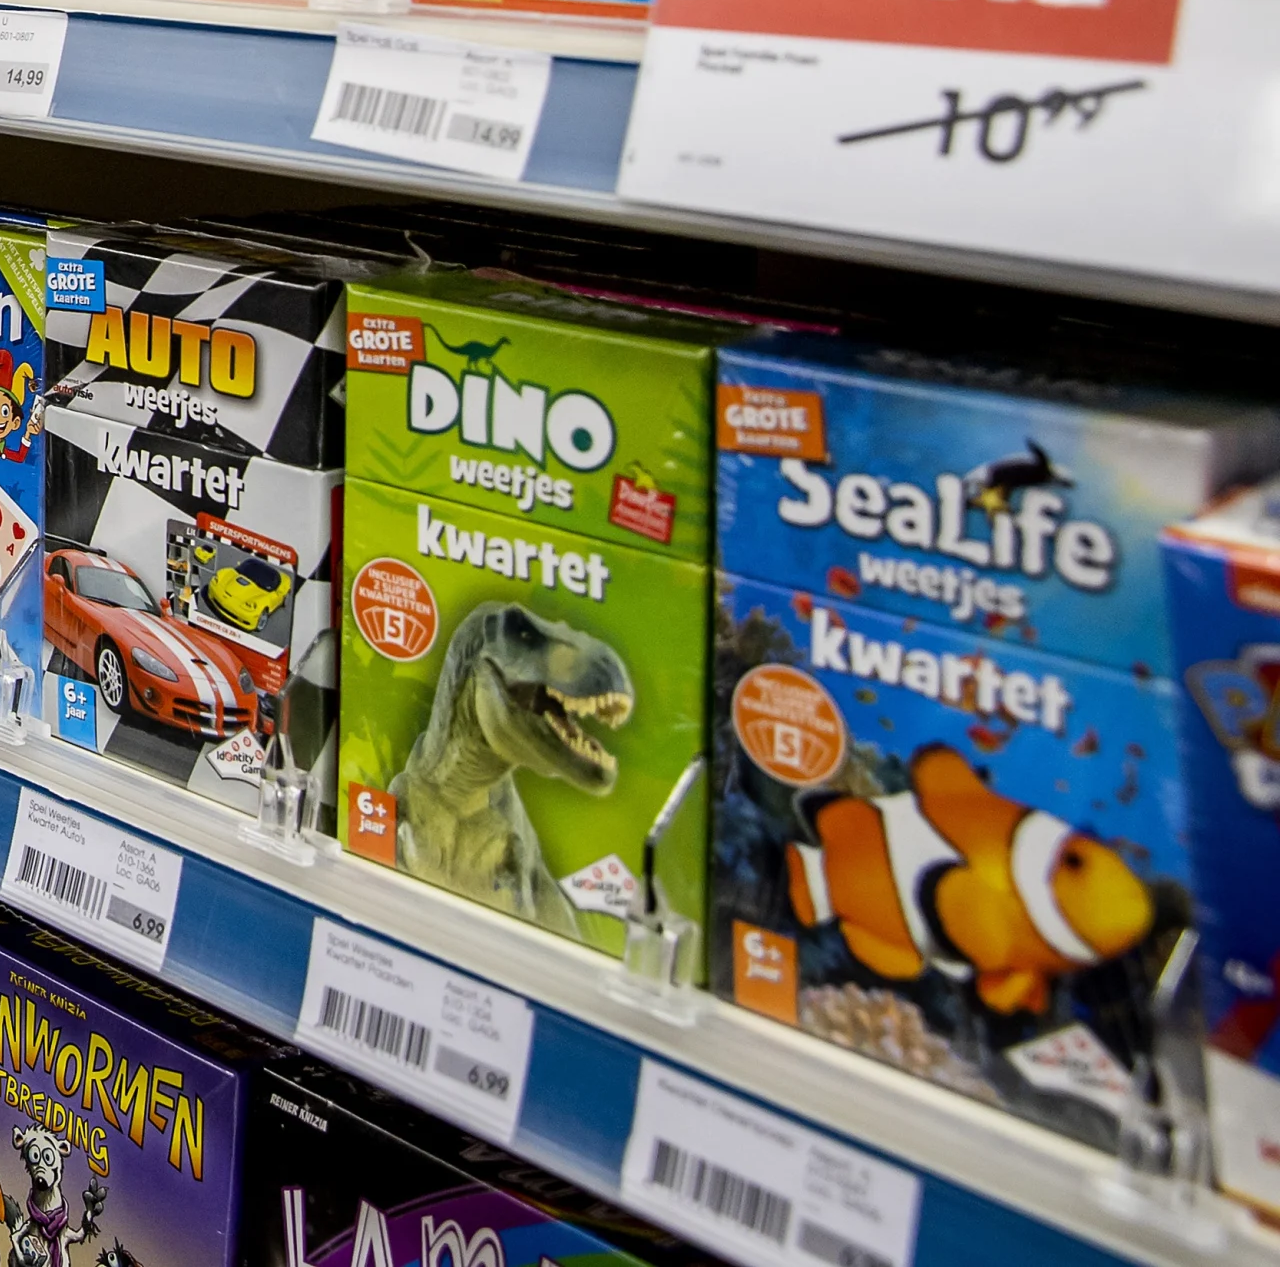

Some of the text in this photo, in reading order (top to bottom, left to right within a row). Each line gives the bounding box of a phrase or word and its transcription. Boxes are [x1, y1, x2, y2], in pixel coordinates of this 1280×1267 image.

[6, 68, 44, 88] 14,99
[47, 272, 96, 292] GROTE
[58, 261, 83, 274] extra
[53, 291, 91, 307] kaarten
[362, 317, 396, 331] extra
[85, 304, 257, 399] AUTO
[348, 328, 414, 352] GROTE
[357, 350, 407, 368] kaarten
[52, 383, 94, 401] autovisie
[123, 382, 219, 430] weetjes
[409, 363, 616, 473] DINO
[725, 403, 811, 433] GROTE
[96, 427, 246, 509] kwartet
[449, 454, 574, 512] weetjes
[778, 457, 1116, 590] SeaLife
[209, 520, 292, 560] SUPERSPORTWAGENS
[416, 503, 611, 602] kwartet
[367, 566, 423, 590] INCLUSIEF
[383, 582, 418, 601] SUPER
[858, 551, 1027, 621] weetjes
[357, 585, 432, 616] KWARTETTEN
[386, 610, 403, 637] 5
[810, 606, 1071, 733] kwartet
[63, 681, 88, 705] 6+
[65, 704, 87, 721] jaar
[28, 798, 81, 831] Spel Weetjes
[356, 791, 387, 818] 6+
[27, 811, 86, 846] Kwartet Auto's
[358, 815, 386, 835] jaar
[119, 839, 157, 864] Assort. A
[115, 863, 162, 893] Loc. GA06
[132, 912, 166, 939] 6,99
[742, 931, 782, 961] 6+
[744, 957, 782, 985] jaar
[9, 969, 88, 1021] REINER KNIZIA
[467, 1064, 510, 1096] 6,99
[269, 1091, 329, 1132] REINER KNIZIA
